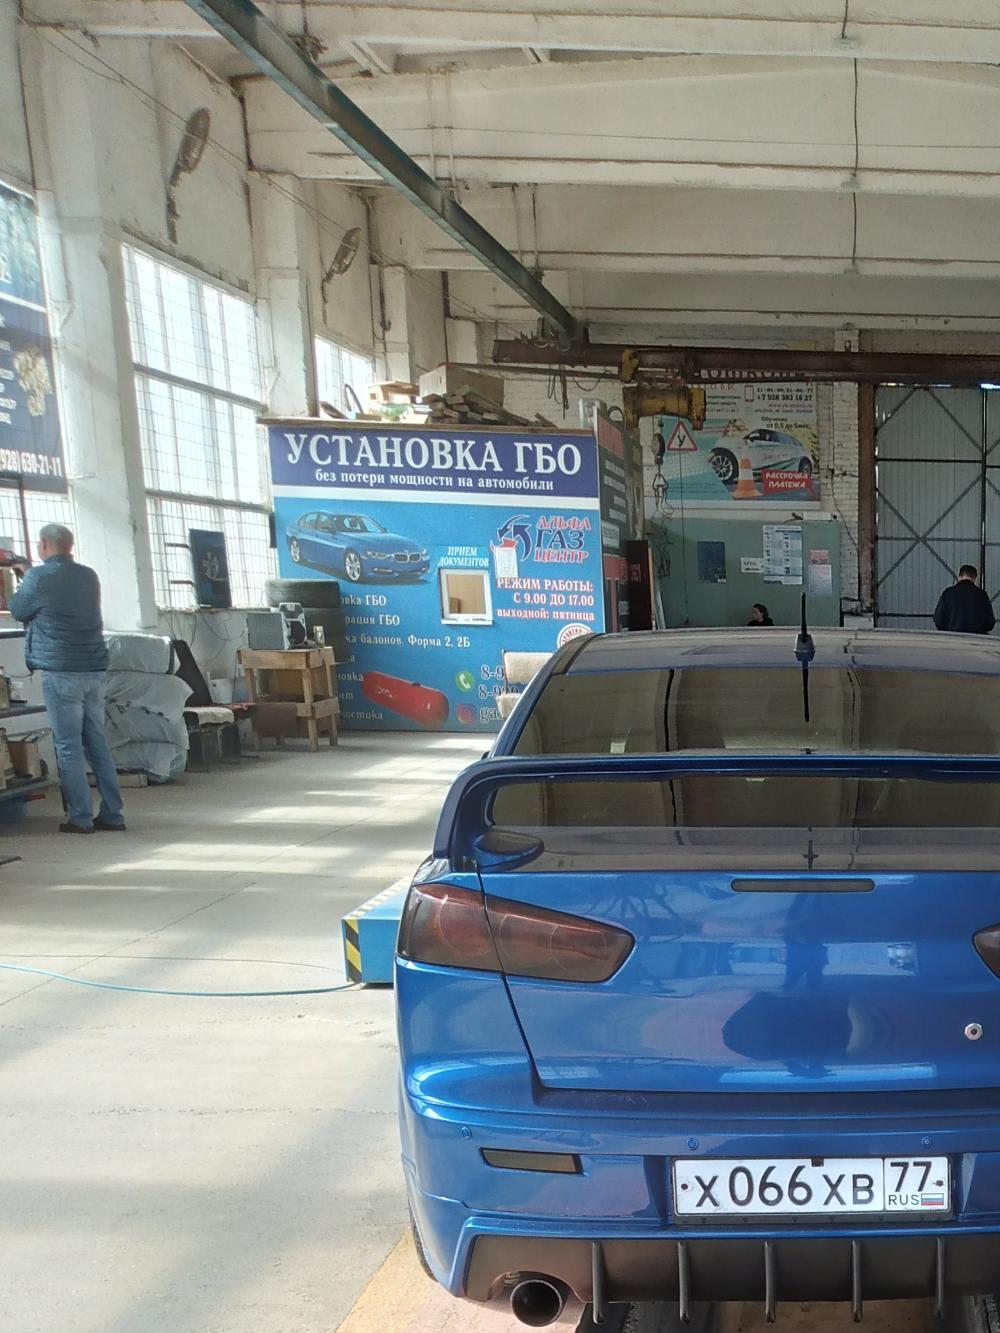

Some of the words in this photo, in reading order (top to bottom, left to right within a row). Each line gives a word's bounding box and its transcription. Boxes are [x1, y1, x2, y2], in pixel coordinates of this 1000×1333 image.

[284, 433, 503, 472] УСТАНОВКА
[514, 442, 582, 475] ГБО
[315, 468, 336, 483] без
[341, 471, 385, 487] потери
[390, 473, 453, 488] мощности
[458, 478, 473, 488] на
[478, 477, 554, 491] автомобили
[765, 472, 808, 480] РАССРОЧКА
[768, 481, 806, 489] ПЛАТЕЖА
[536, 515, 592, 531] АЛЬФА
[536, 529, 585, 550] ГАЗ
[448, 546, 477, 557] ПРИЕМ
[534, 548, 590, 563] ЦЕНТР
[438, 557, 489, 568] ДОКУМЕНТОВ
[497, 578, 541, 591] РЕЖИМ
[544, 579, 593, 592] РАБОТЫ:
[365, 594, 387, 607] ГБО
[513, 593, 521, 604] С
[524, 593, 547, 605] 9.00
[550, 594, 565, 607] ДО
[569, 594, 594, 607] 17.00
[378, 614, 400, 626] ГБО
[497, 607, 549, 620] выходной:
[552, 611, 595, 622] пятница
[407, 634, 441, 649] Форма
[457, 637, 471, 648] 2Б
[890, 1161, 933, 1192] 77
[888, 1194, 920, 1206] RUS
